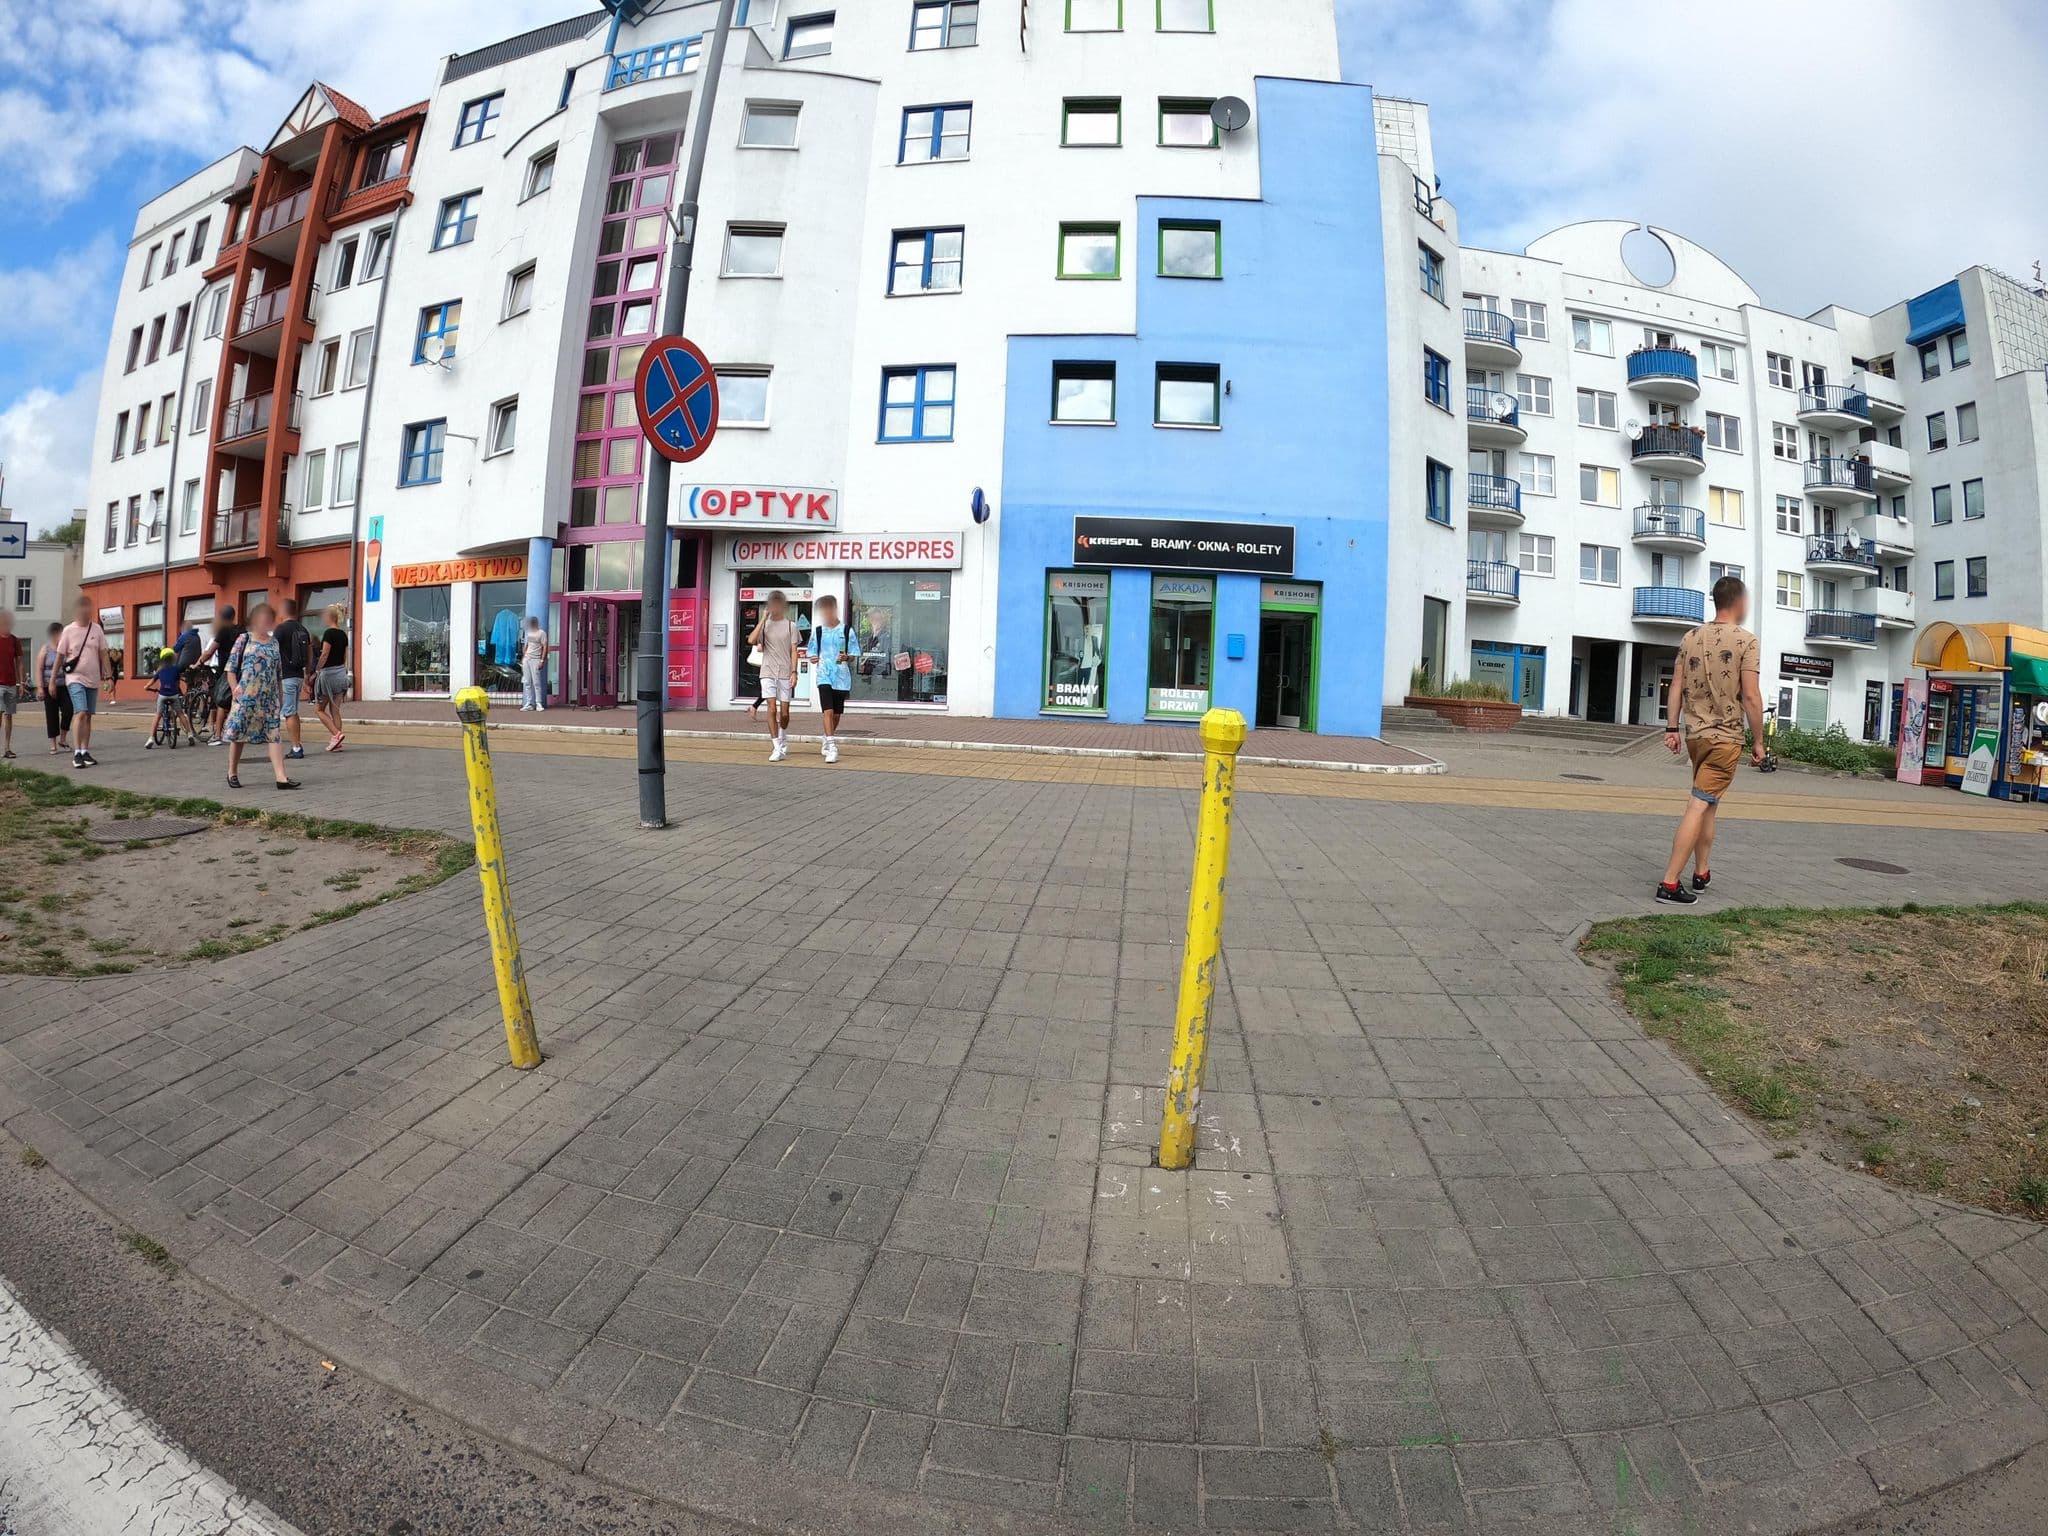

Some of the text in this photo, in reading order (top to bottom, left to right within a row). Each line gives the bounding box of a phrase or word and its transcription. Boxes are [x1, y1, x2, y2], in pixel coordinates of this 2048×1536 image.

[701, 489, 830, 520] OPTYK
[738, 540, 954, 560] OPTIK CENTER EKSPRES
[1089, 537, 1281, 555] KRISPOL BRAMY OKNA ROLETY
[393, 557, 523, 587] WĘDKARSTWO
[1062, 581, 1105, 589] KRISHOME
[1159, 583, 1207, 593] ARKADA
[1274, 590, 1316, 598] KRISHOME
[1783, 655, 1799, 663] BIURO
[1056, 683, 1099, 694] BRAMY
[1160, 688, 1205, 699] ROLETY
[1056, 695, 1089, 706] OKNA
[1159, 700, 1199, 711] DRZWI
